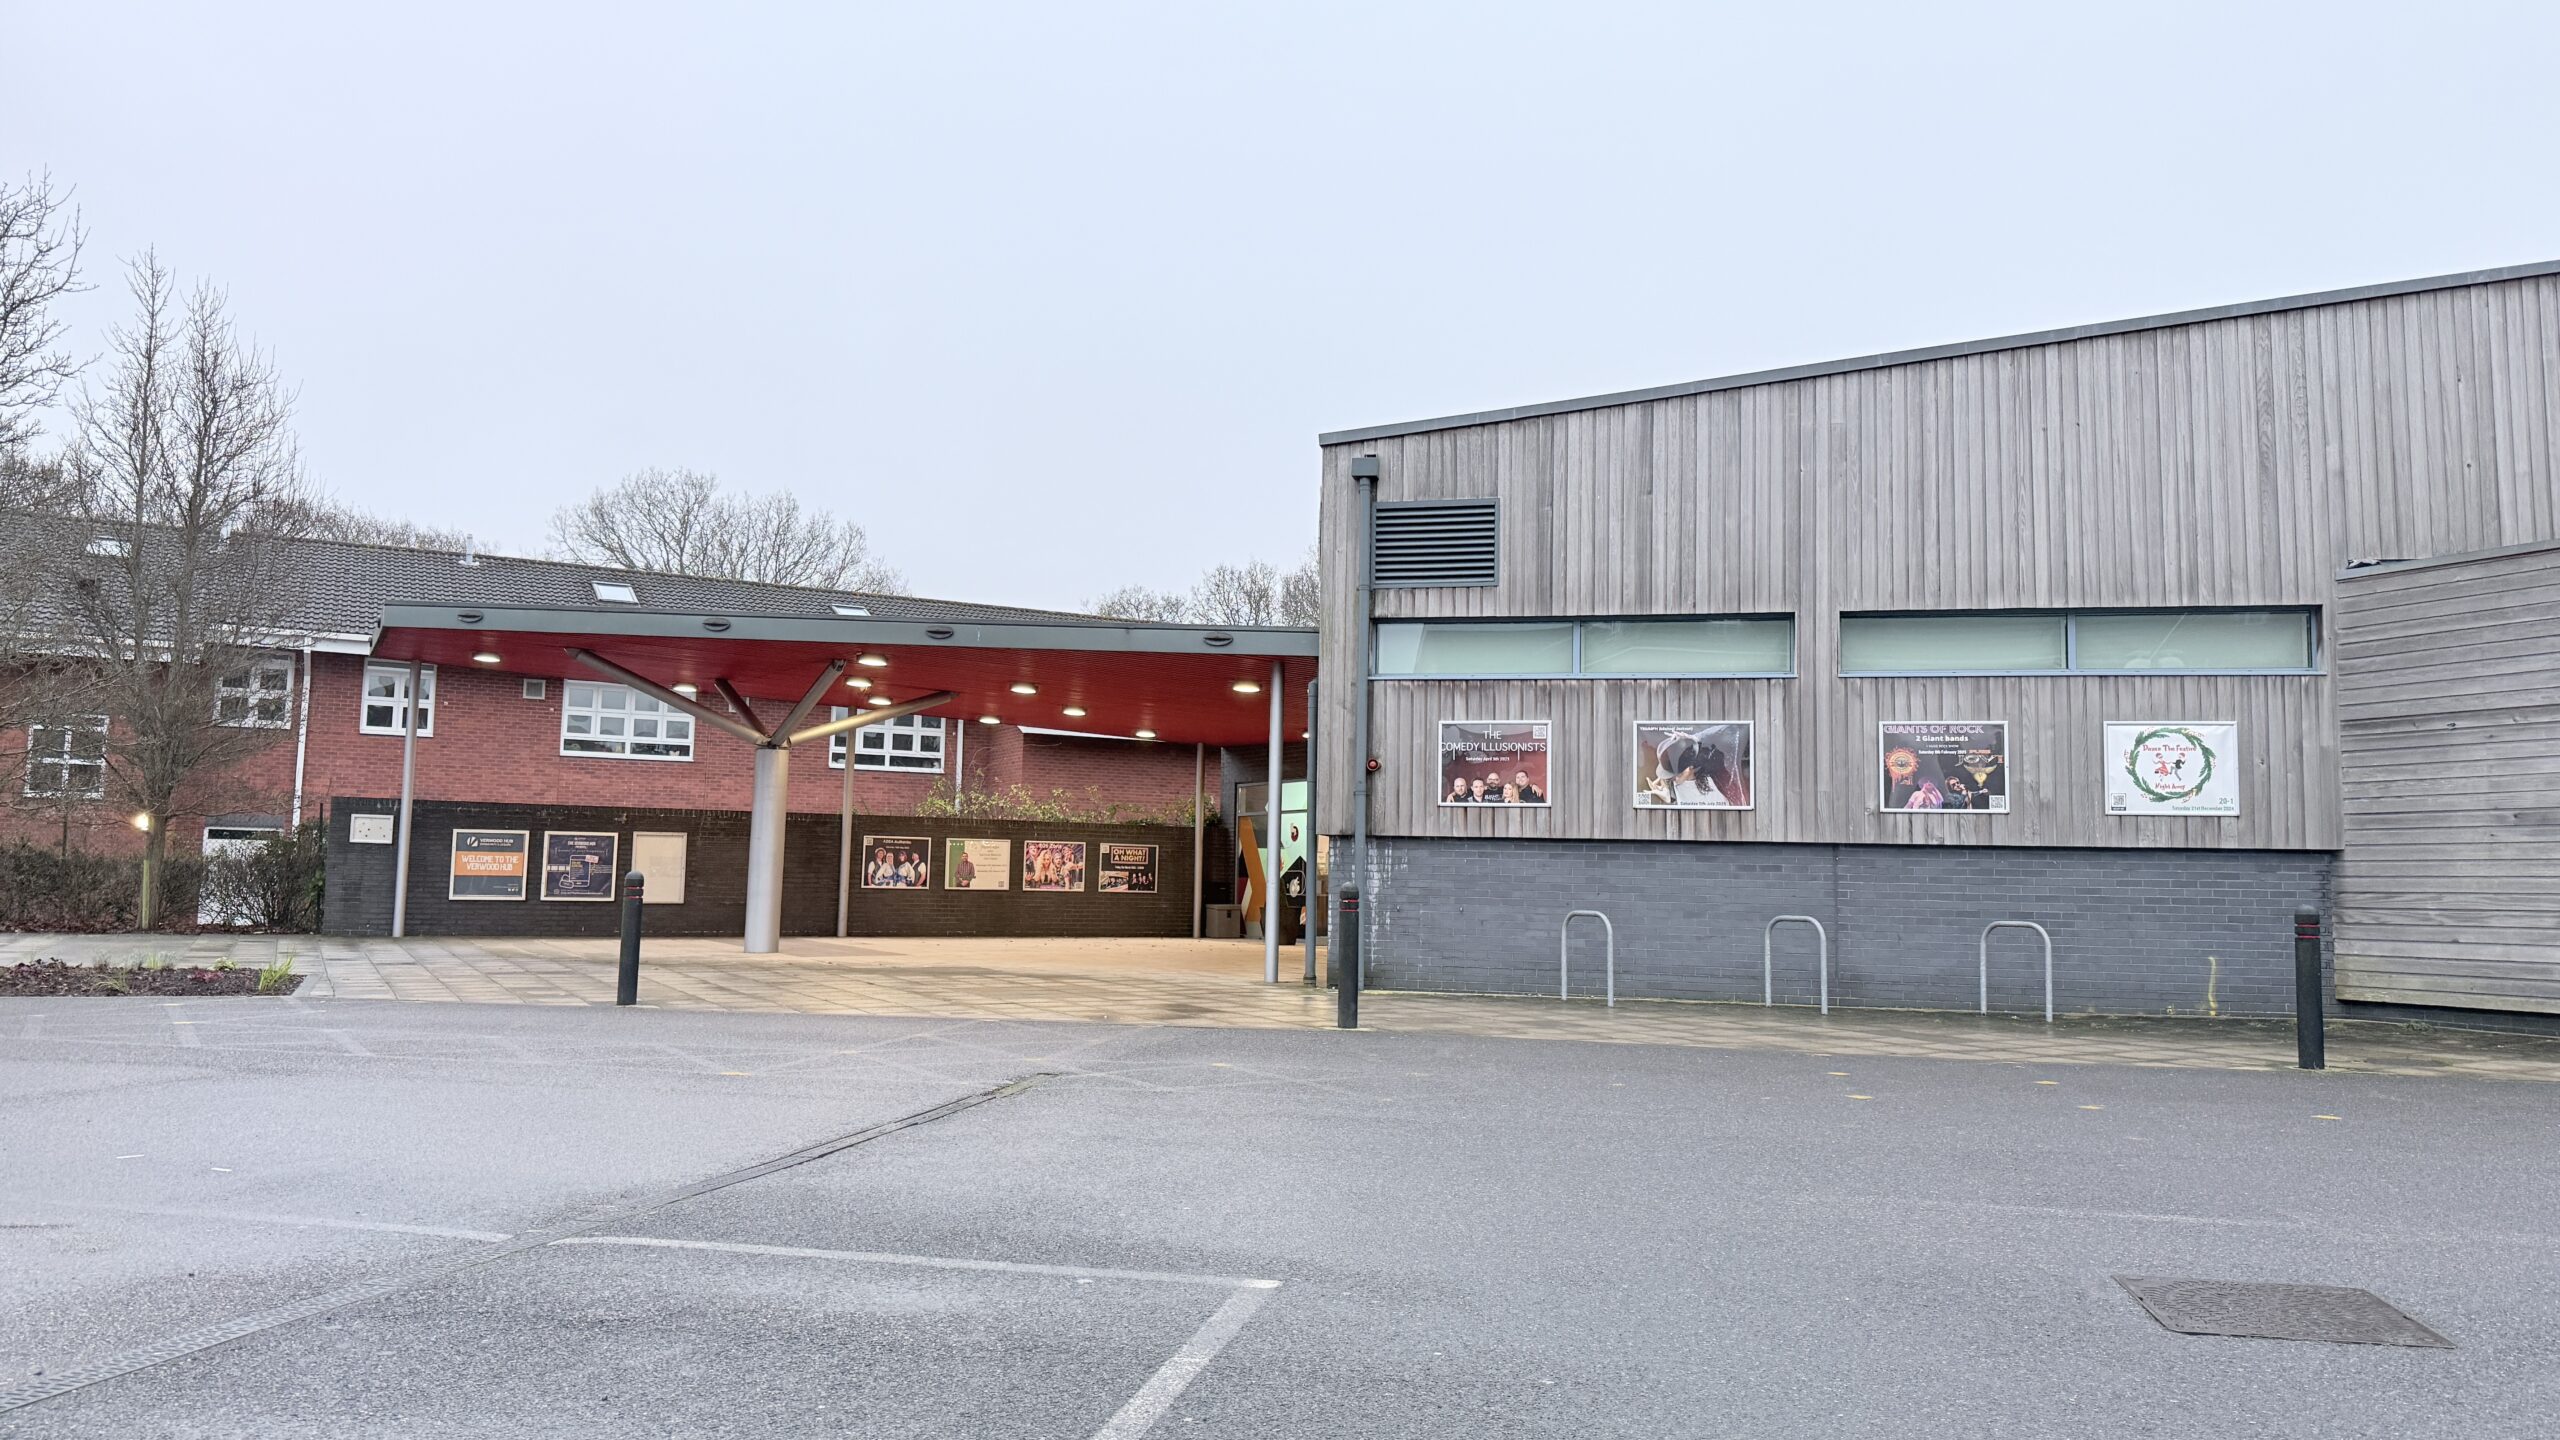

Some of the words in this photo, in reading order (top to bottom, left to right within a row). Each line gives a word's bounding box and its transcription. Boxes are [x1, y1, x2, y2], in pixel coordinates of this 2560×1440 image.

[1483, 726, 1502, 740] THE
[1884, 725, 1928, 734] GIANTS
[1930, 725, 1947, 734] OF
[1949, 725, 1984, 734] ROCK
[1441, 742, 1480, 754] COMEDY
[1481, 742, 1546, 754] ILLUSIONISTS
[2162, 744, 2175, 752] The
[462, 855, 494, 863] WELCOME
[496, 855, 504, 863] TO
[506, 855, 519, 864] THE
[467, 863, 500, 871] VERWOOD
[500, 863, 513, 871] HUB
